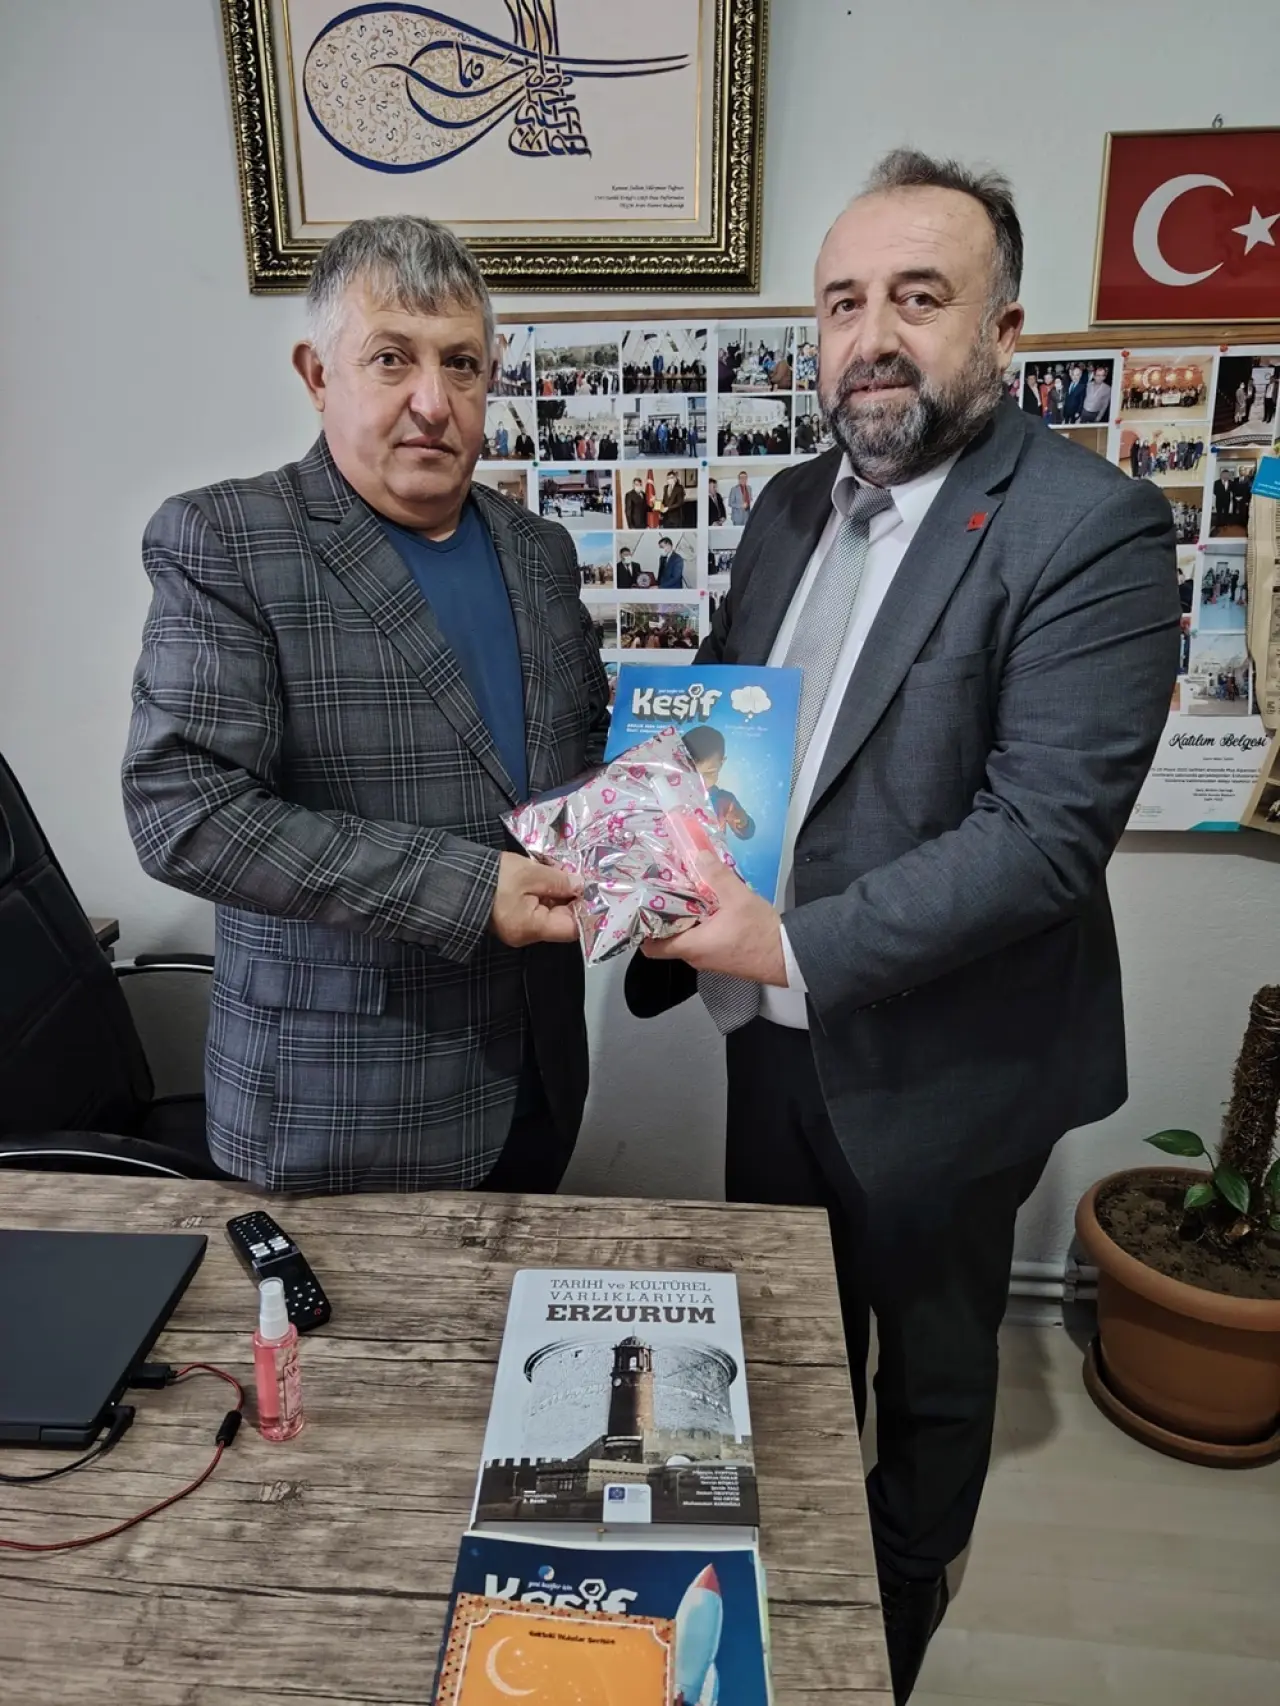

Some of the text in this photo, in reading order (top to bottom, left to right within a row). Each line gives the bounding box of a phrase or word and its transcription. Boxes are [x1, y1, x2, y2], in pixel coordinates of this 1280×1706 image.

[632, 683, 722, 720] Keşif
[1169, 733, 1268, 751] Katılım Belgesi
[551, 1278, 603, 1289] TARİHİ
[629, 1280, 711, 1291] KÜLTÜREL
[550, 1291, 714, 1303] VARLIKLARIYLA
[546, 1304, 716, 1324] ERZURUM
